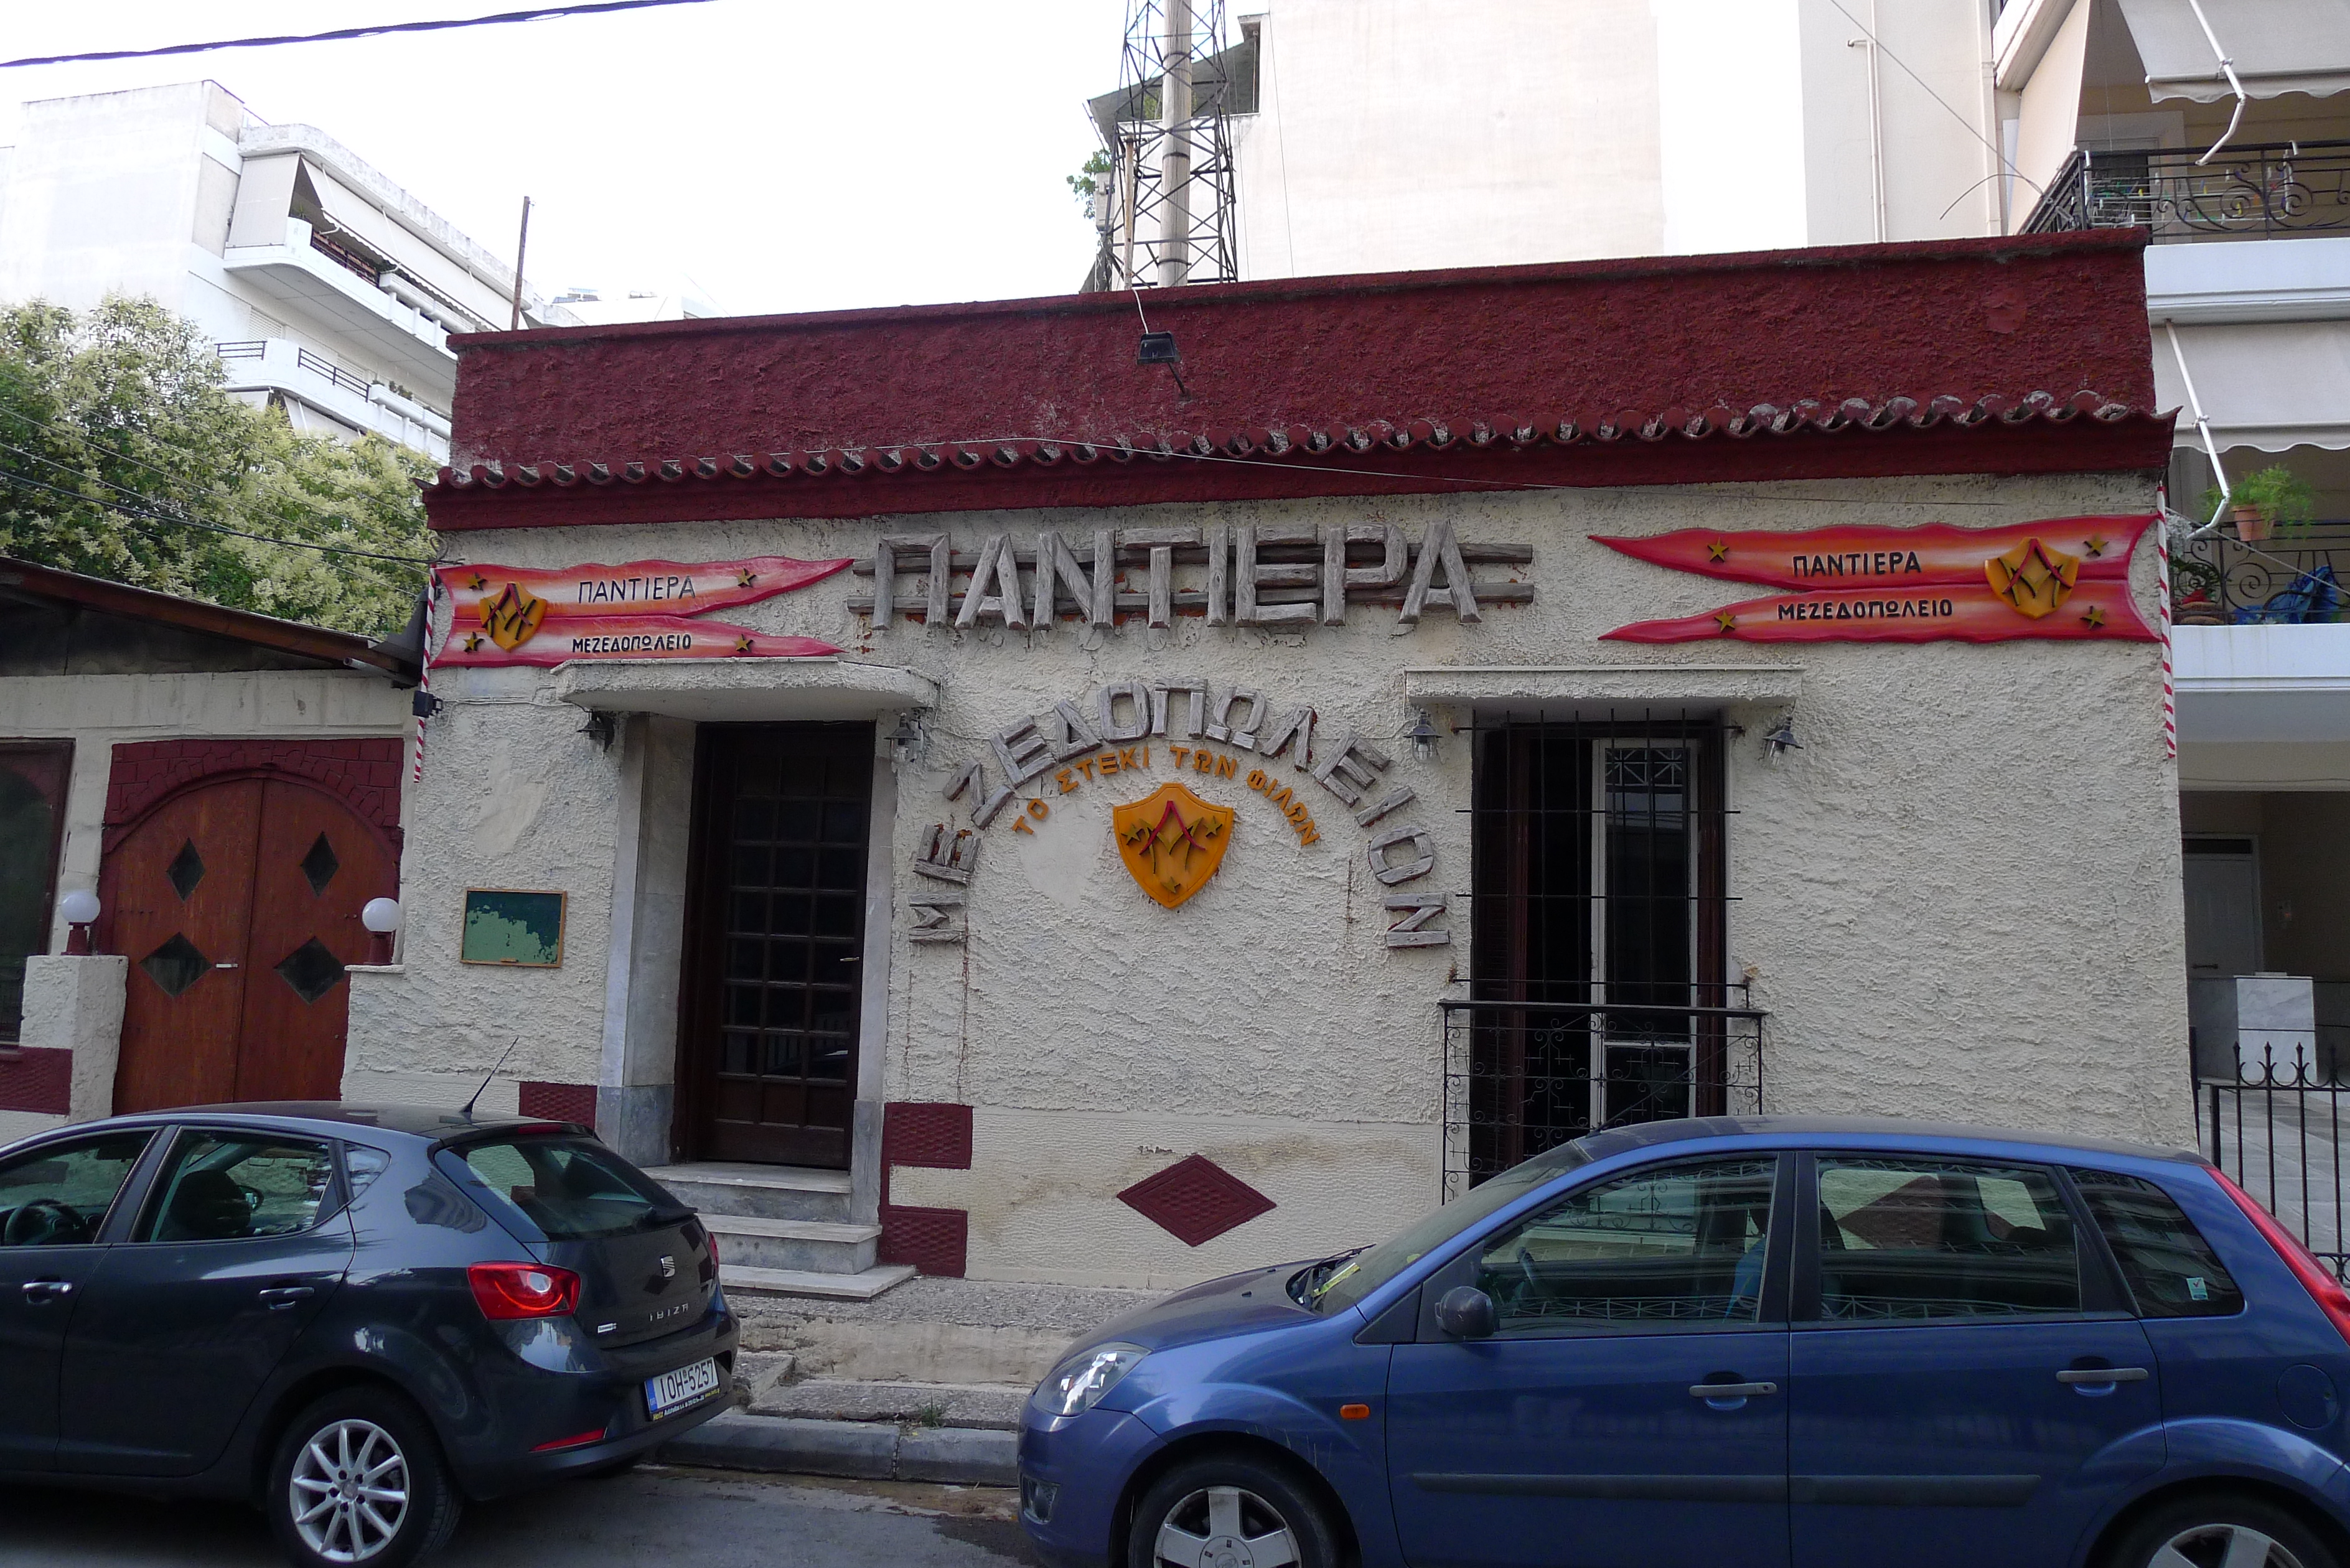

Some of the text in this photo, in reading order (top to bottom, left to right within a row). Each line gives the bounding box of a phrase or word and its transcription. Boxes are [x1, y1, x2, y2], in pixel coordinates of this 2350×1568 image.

[872, 519, 1483, 631] ΠΑΝΤΙΕΡΑ
[1792, 551, 1922, 577] ΠΑΝΤΙΕΡΑ
[578, 575, 696, 604] ΠΑΝΤΙΕΡΑ
[1777, 599, 1953, 620] ΜΕΖΕΔΟΠΩΛΕΙΟ
[572, 633, 692, 653] ΜΕΖΕΔΟΠΩΛΕΙΟ
[1011, 746, 1321, 847] ΤΟ ΣΤΕΚΙ ΤΩΝ ΦΙΛΩΝ
[909, 677, 1451, 949] ΜΕΖΕΔΟΠΩΛΕΙΟΝ
[650, 1303, 688, 1322] IBIZA
